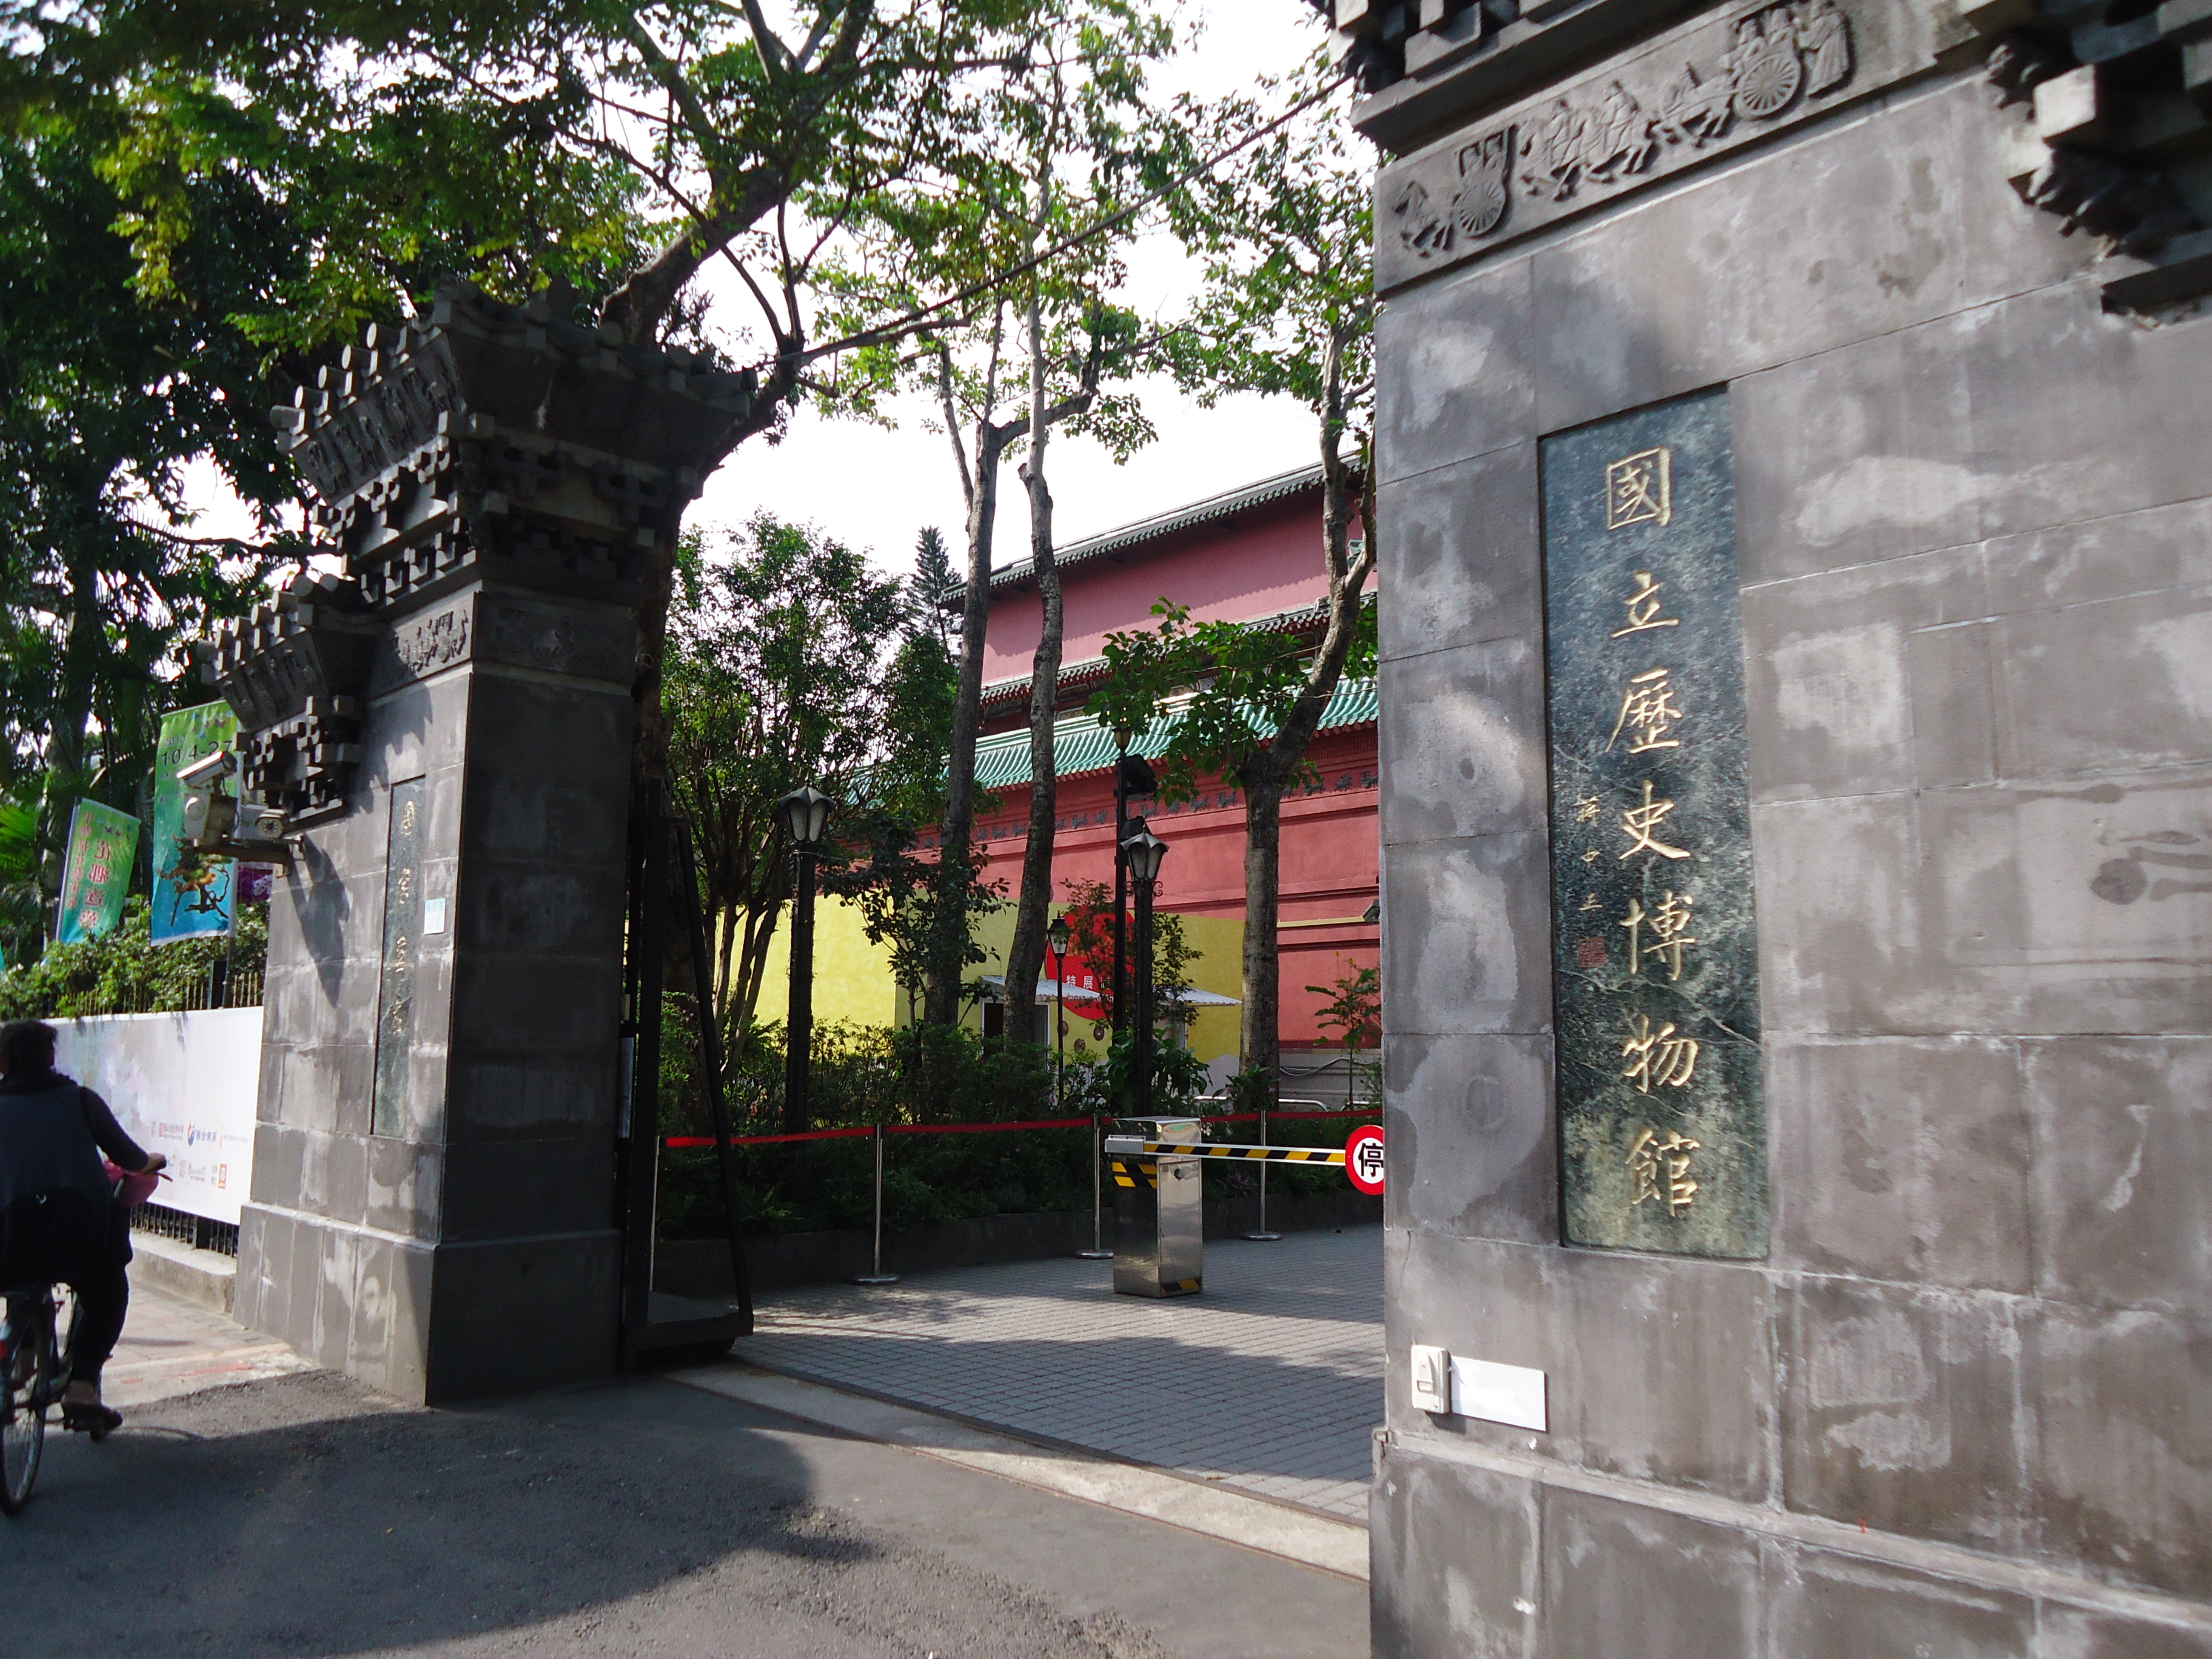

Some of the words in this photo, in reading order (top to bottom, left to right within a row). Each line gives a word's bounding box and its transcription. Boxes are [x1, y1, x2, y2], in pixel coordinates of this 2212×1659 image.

[164, 736, 186, 747] 2013
[1575, 796, 1603, 911] 蔣中正
[1605, 446, 1701, 1217] 國立歷史博物館
[1358, 1142, 1384, 1178] 停
